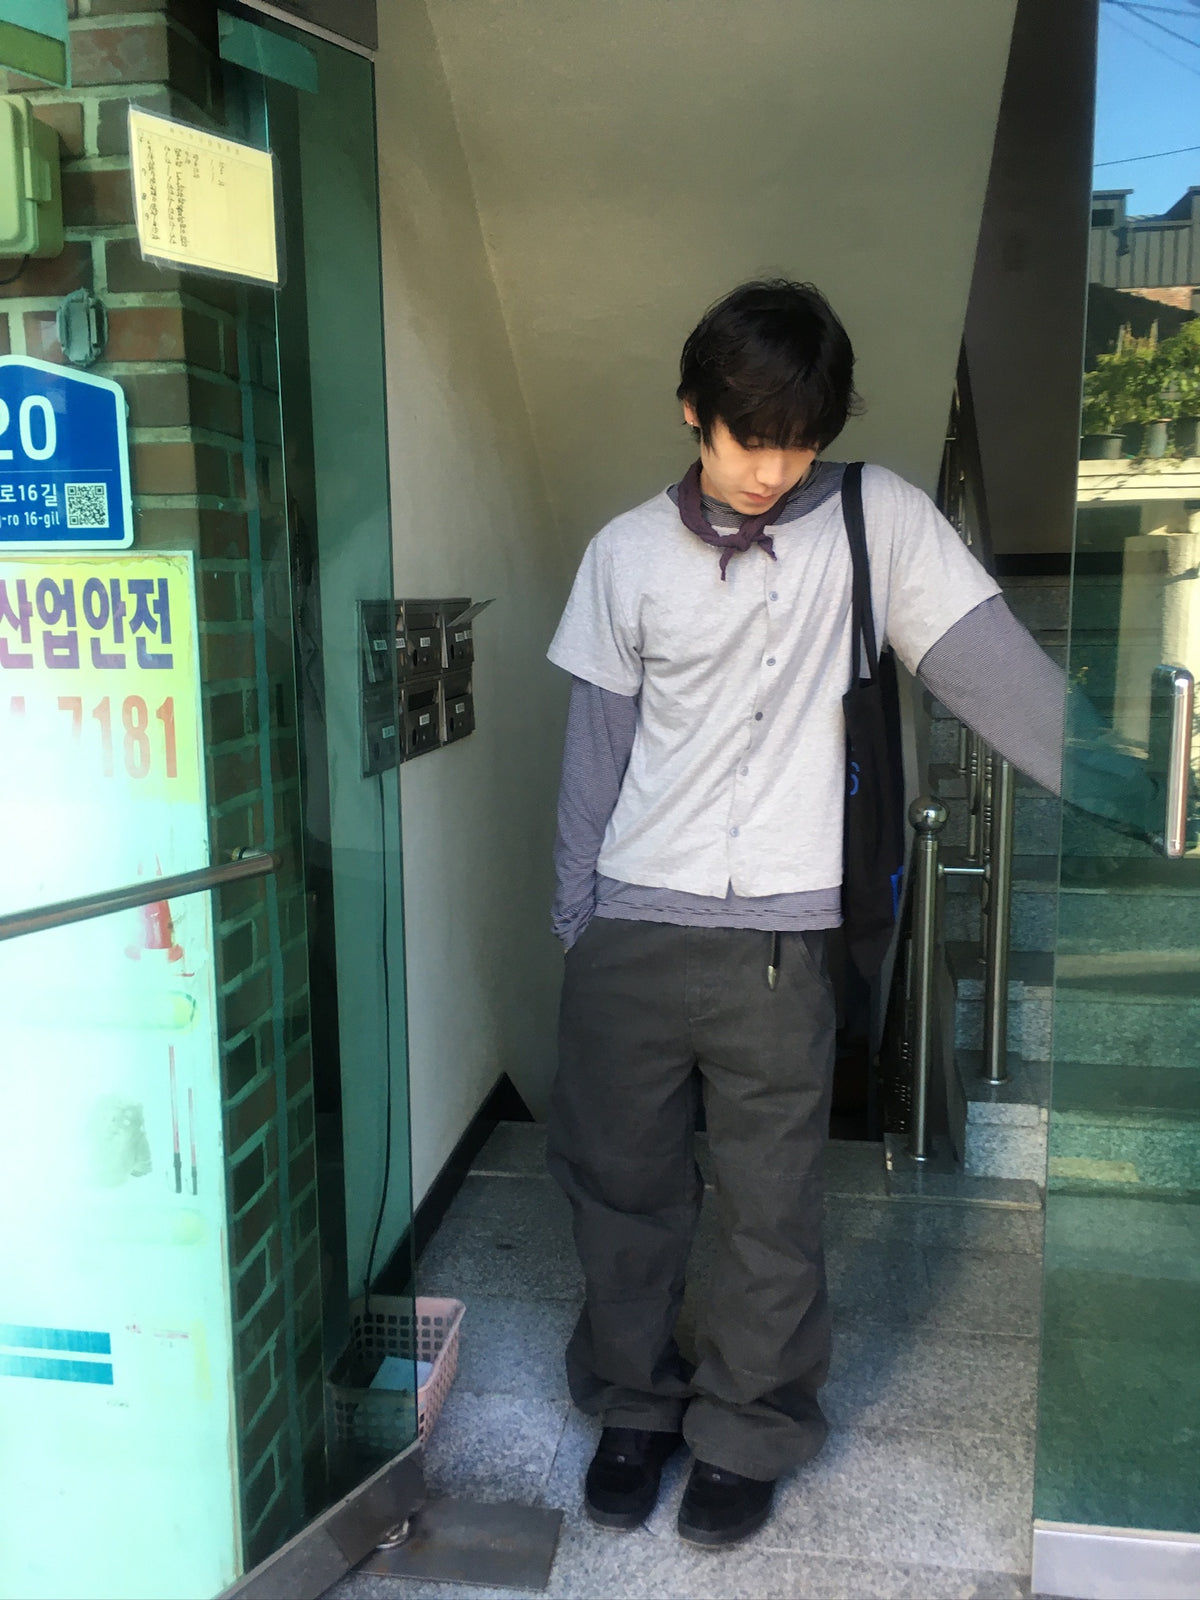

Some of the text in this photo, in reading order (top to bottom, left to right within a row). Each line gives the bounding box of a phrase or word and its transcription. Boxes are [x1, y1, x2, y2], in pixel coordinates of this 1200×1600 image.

[1, 483, 58, 507] 로16길
[0, 511, 60, 529] -ro 16-gil
[0, 577, 174, 669] 산업안전
